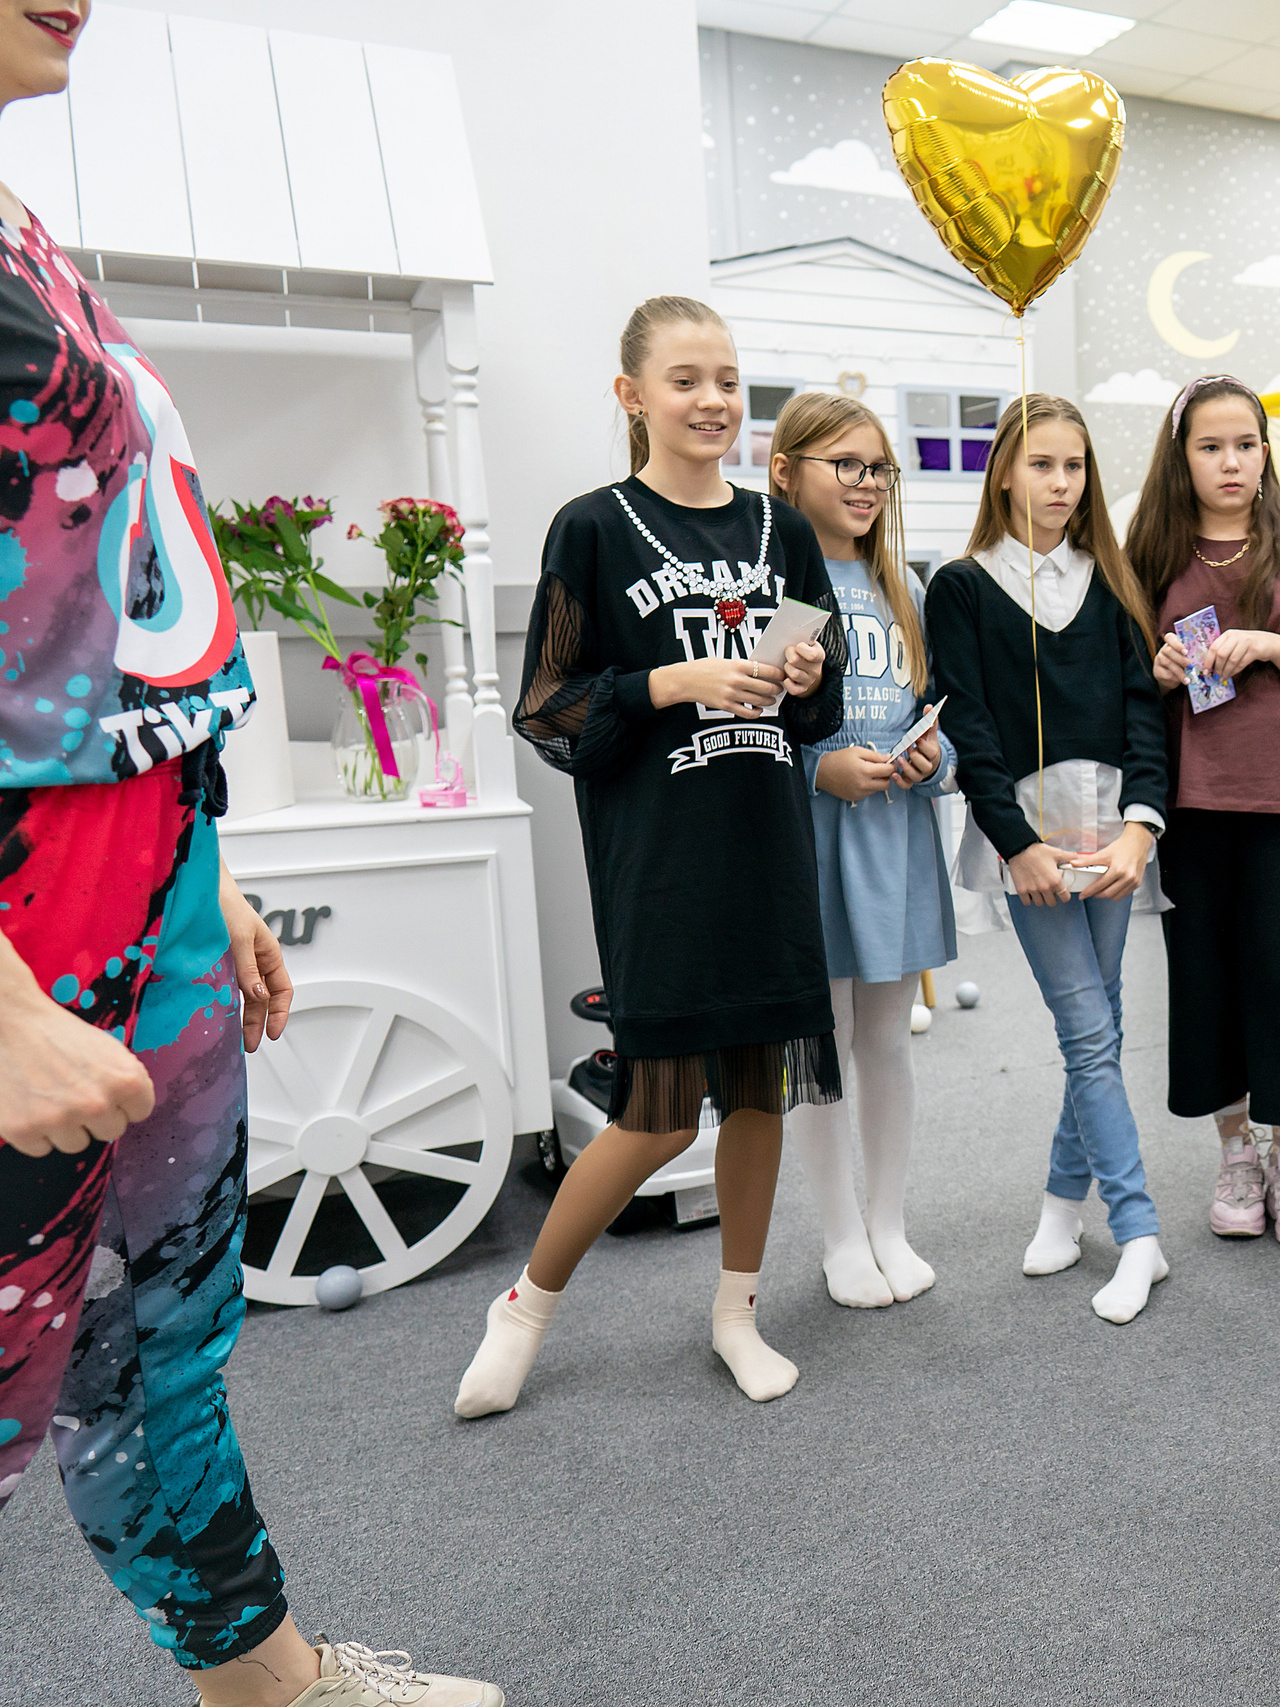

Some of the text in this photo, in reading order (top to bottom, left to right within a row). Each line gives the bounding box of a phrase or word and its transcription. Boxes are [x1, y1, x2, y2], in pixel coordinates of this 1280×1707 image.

[851, 588, 876, 603] CITY
[858, 686, 902, 703] LEAGUE
[843, 705, 888, 720] AM UK
[703, 730, 778, 753] GOOD FUTURE
